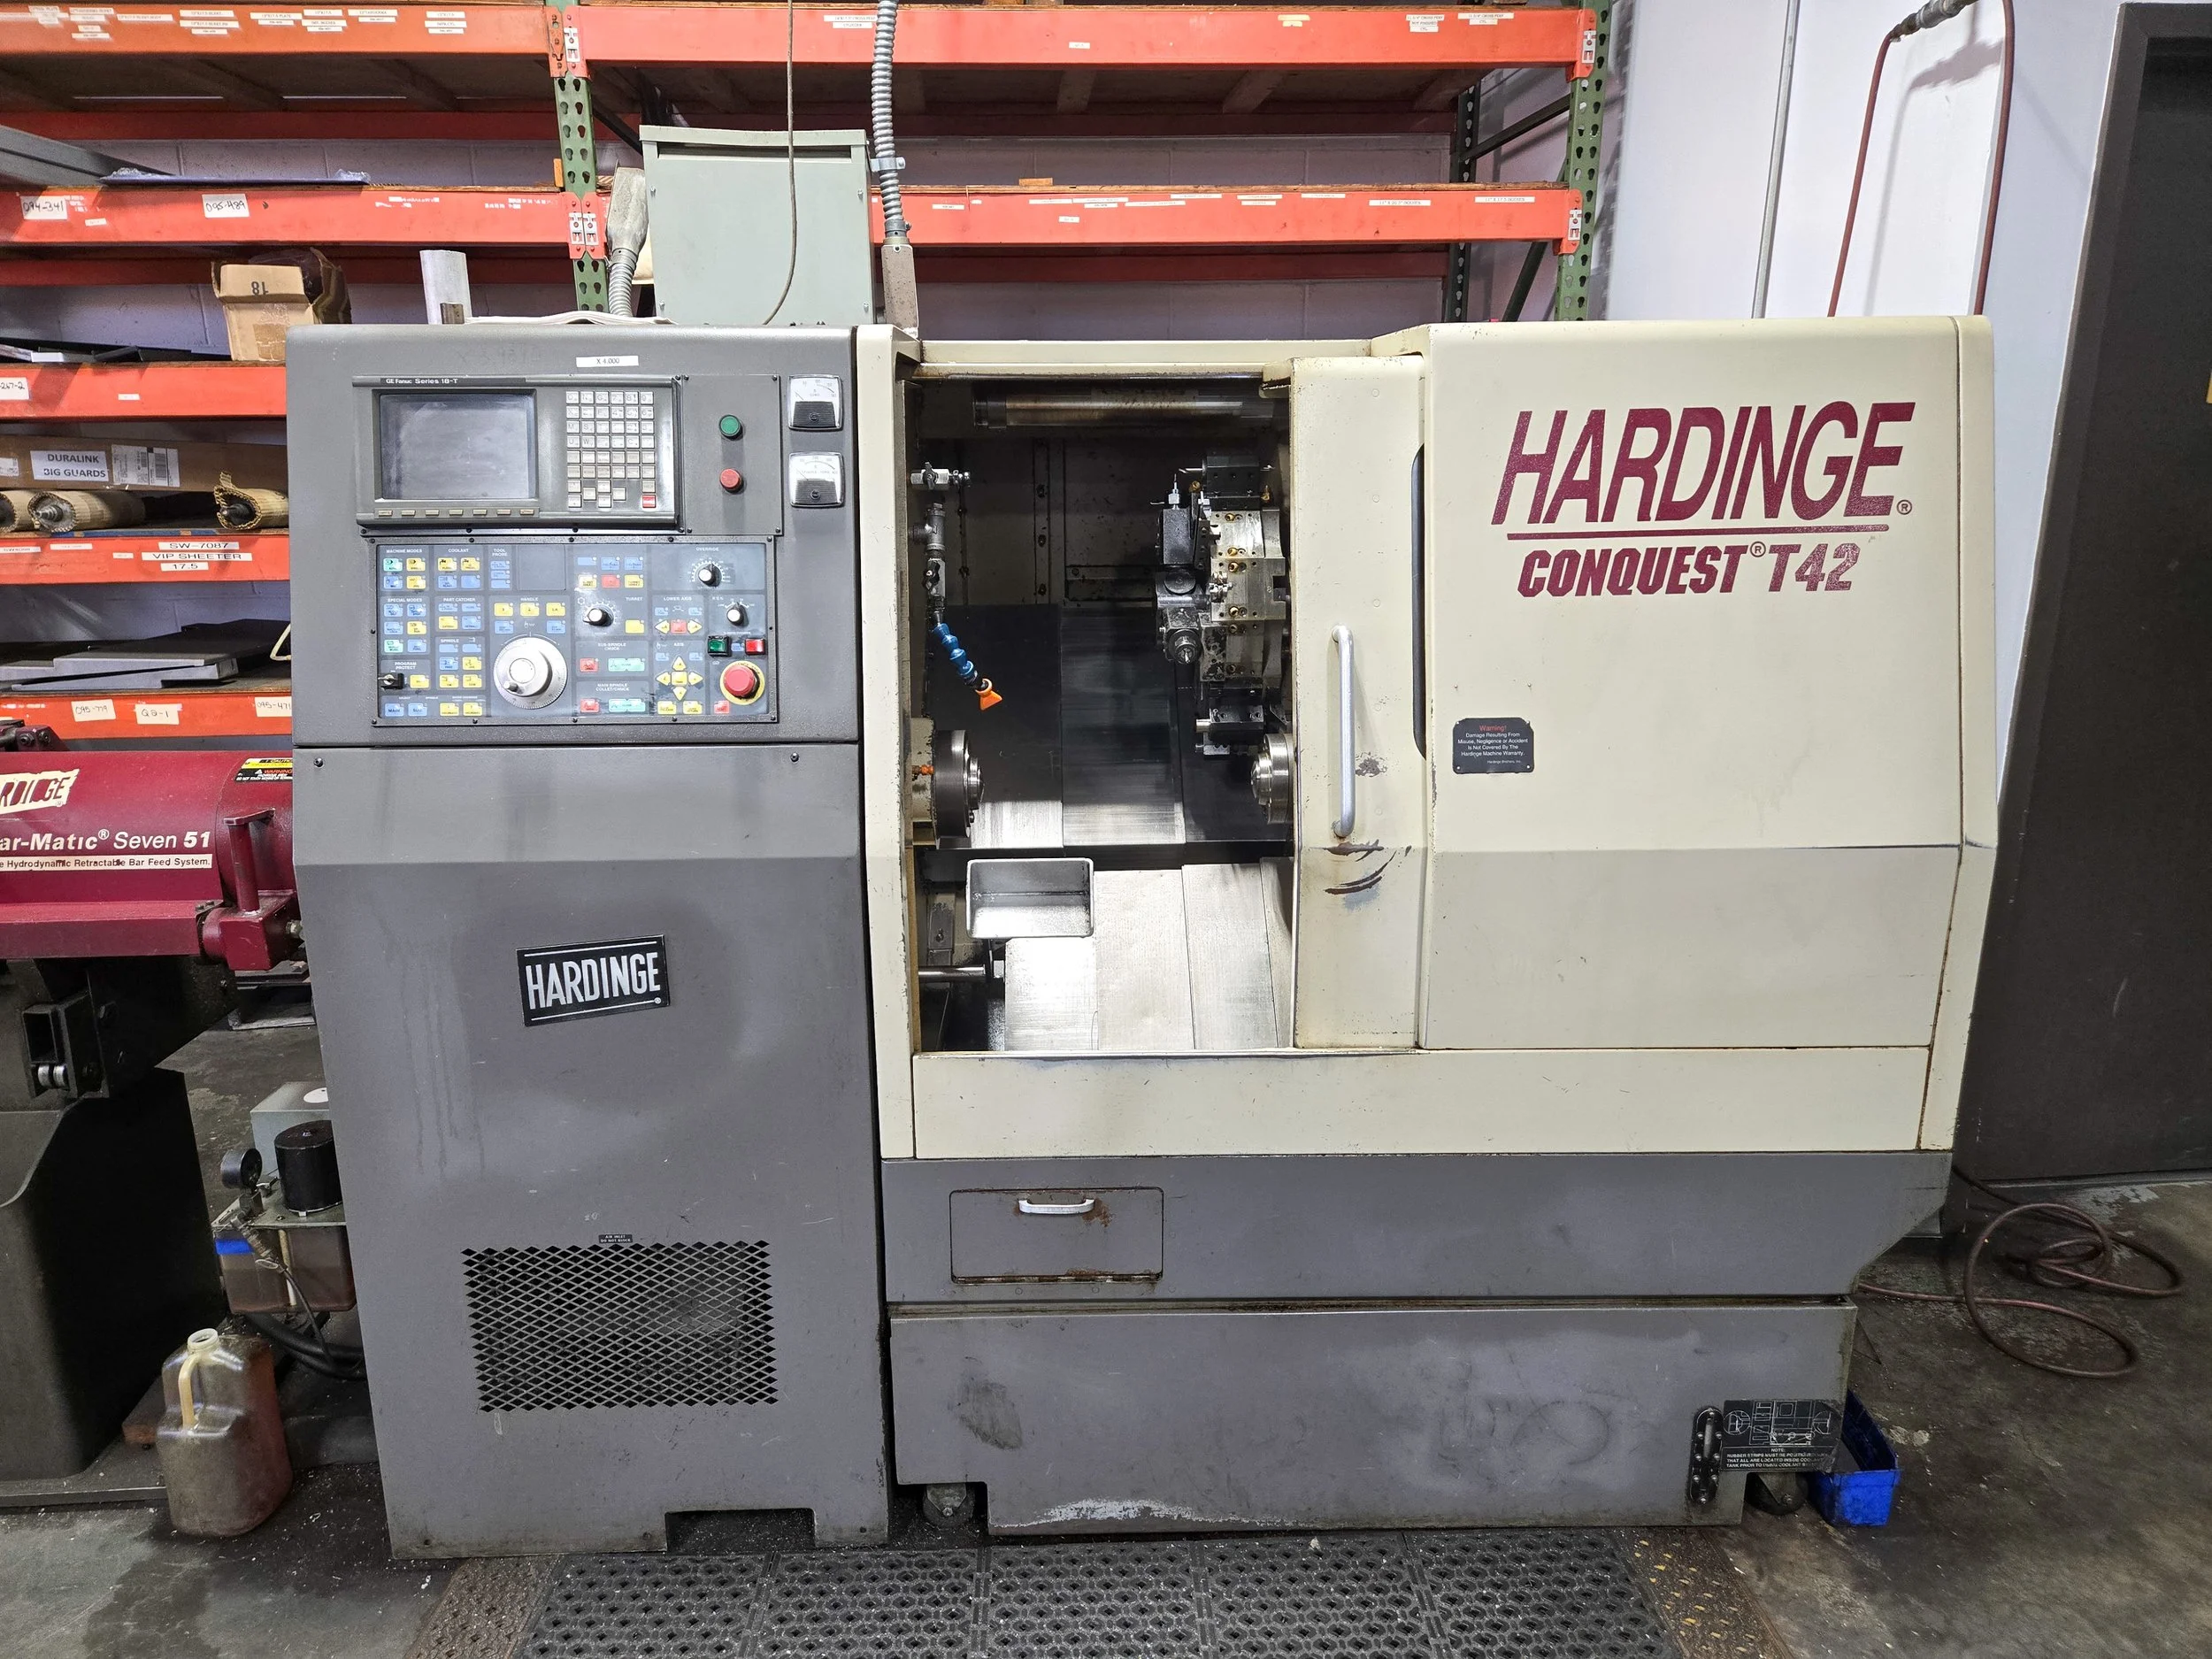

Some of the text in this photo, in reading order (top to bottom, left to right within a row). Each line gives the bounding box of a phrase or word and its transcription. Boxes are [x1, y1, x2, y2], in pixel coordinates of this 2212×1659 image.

[205, 200, 246, 212] 095-489
[47, 453, 99, 464] DURALINK
[64, 468, 106, 478] GUARDS
[1768, 542, 1861, 593] T42
[113, 831, 177, 849] Seven
[183, 831, 211, 849] 51
[7, 859, 72, 870] Hydrodynamic
[74, 858, 126, 867] Retractable
[148, 857, 171, 866] Feed
[174, 857, 211, 868] System.
[525, 952, 661, 1010] HARDINGE
